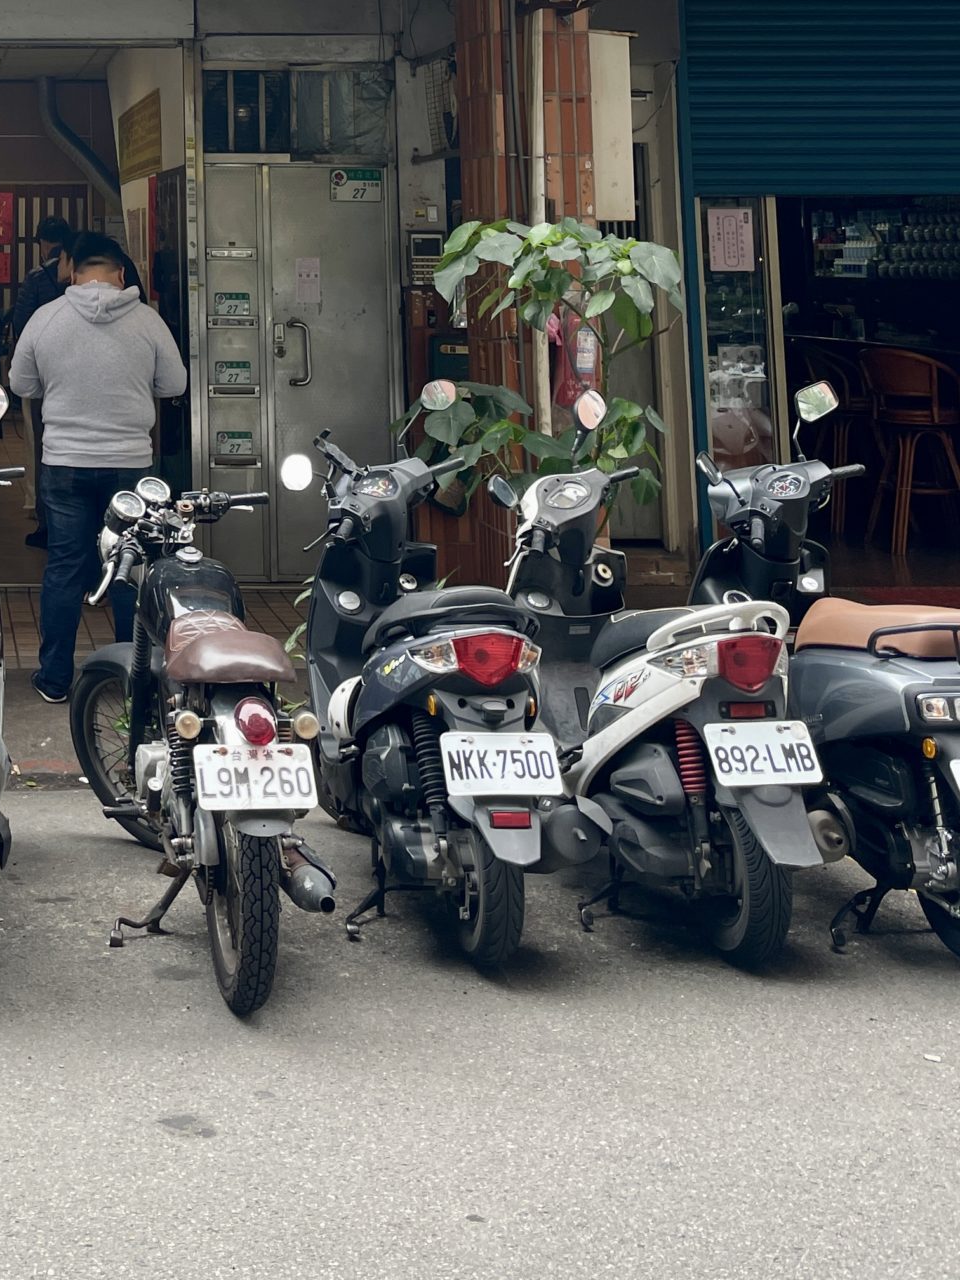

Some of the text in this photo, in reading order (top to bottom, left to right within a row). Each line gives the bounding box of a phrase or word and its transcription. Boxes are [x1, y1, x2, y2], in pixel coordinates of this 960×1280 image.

[352, 188, 367, 199] 27
[226, 305, 238, 314] 27
[227, 373, 239, 383] 27
[229, 443, 241, 454] 27
[232, 749, 273, 761] 台灣省
